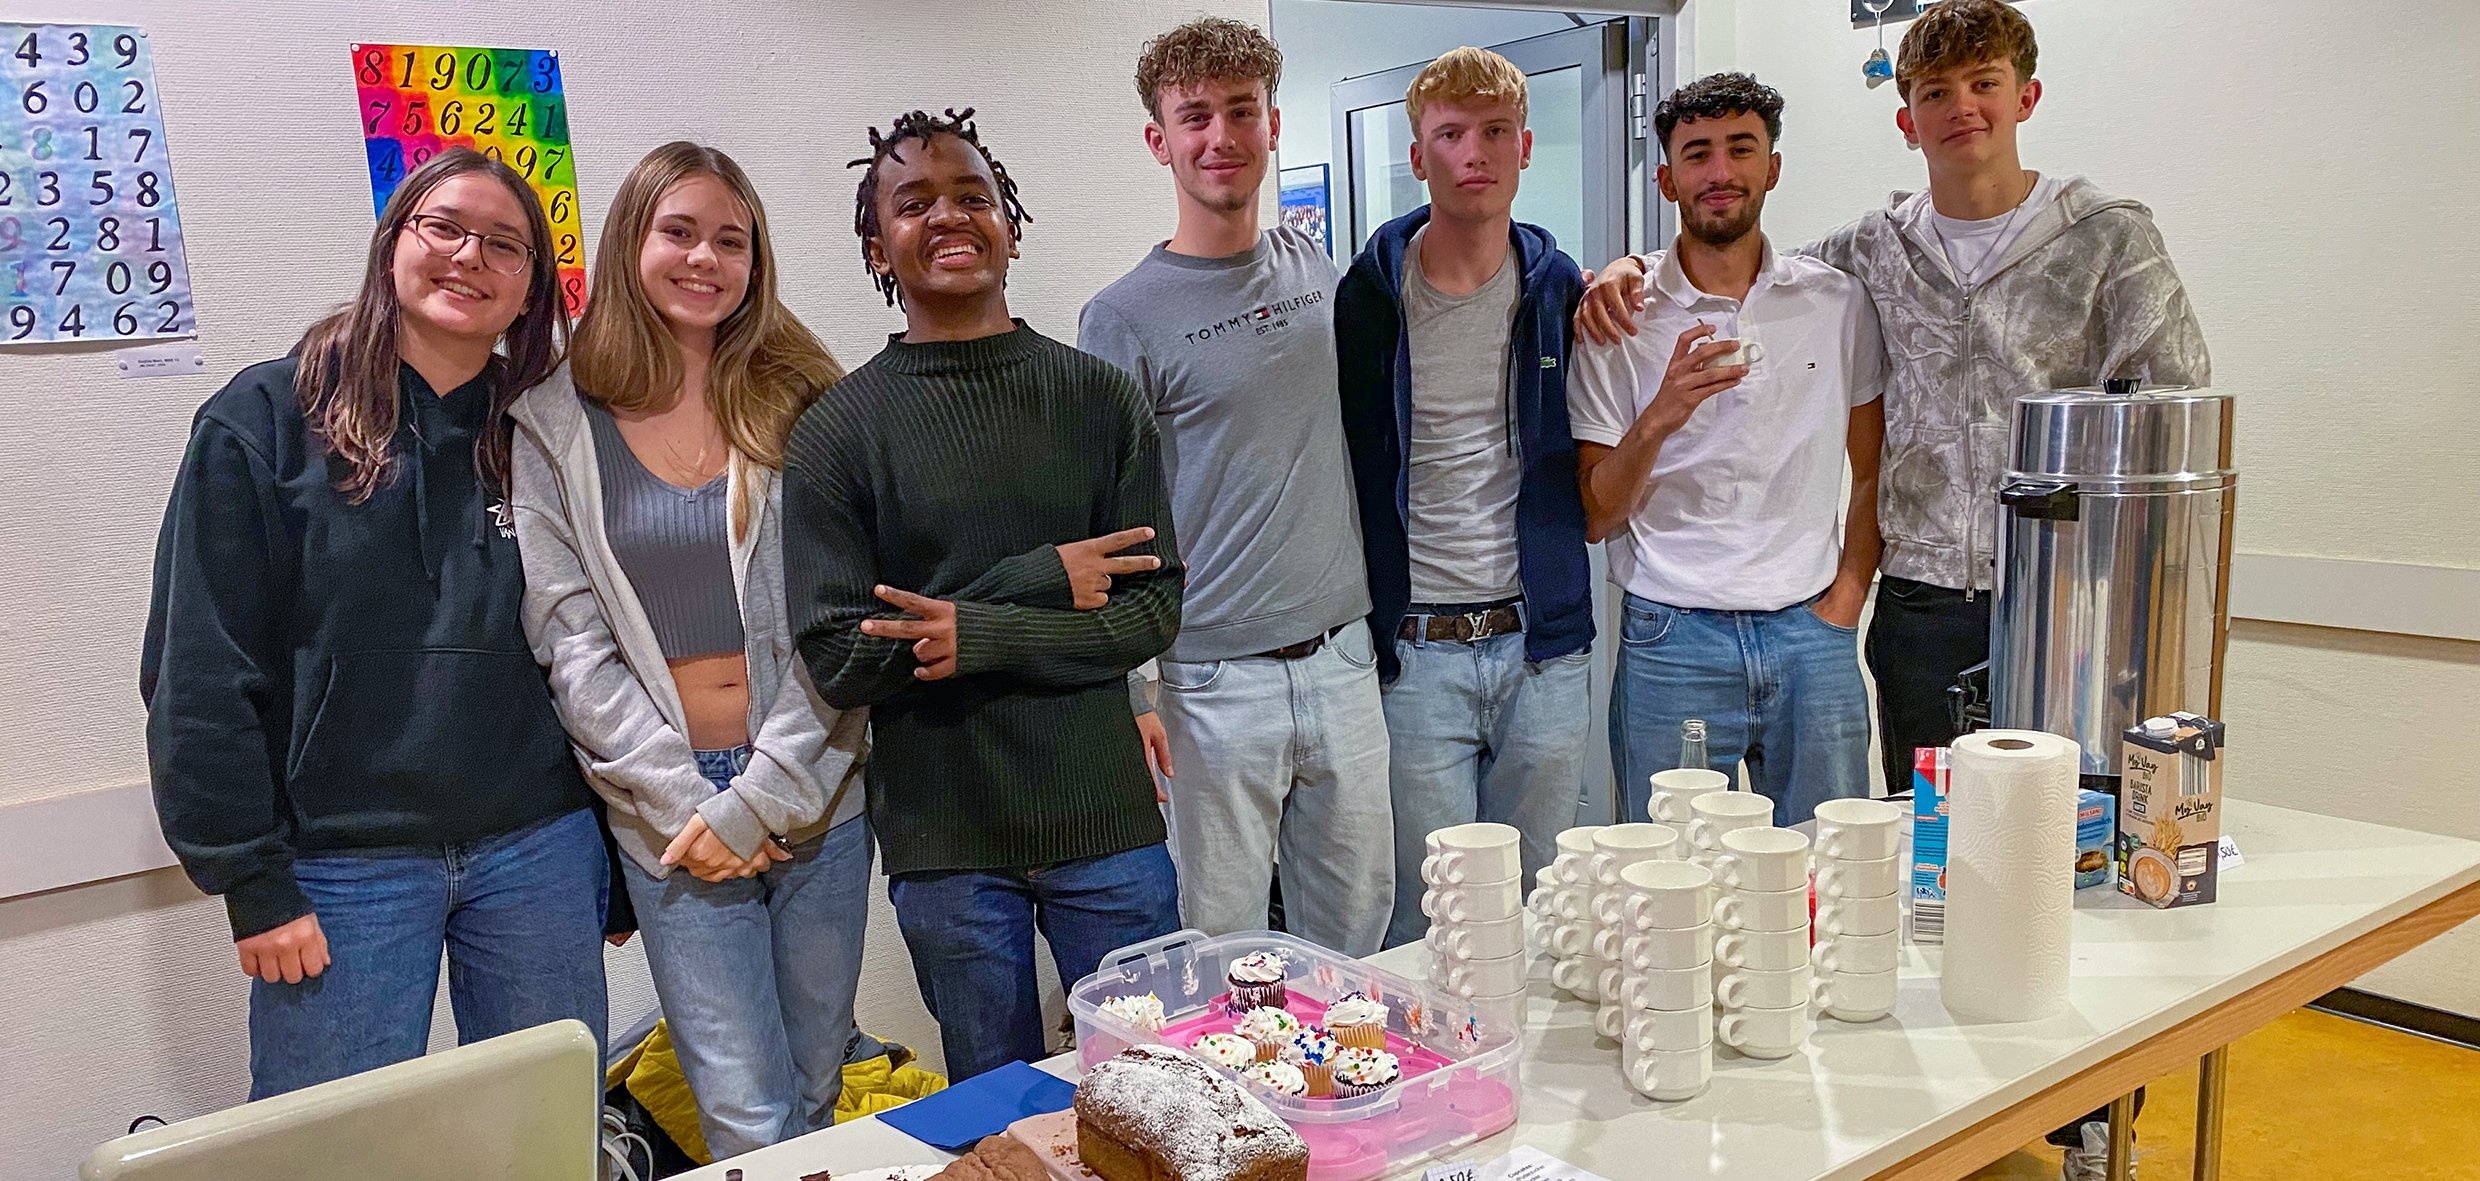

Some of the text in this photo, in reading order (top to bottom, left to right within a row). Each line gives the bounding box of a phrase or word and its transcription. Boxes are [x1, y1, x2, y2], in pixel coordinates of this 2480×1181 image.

[15, 32, 137, 68] 4 3 9
[360, 50, 556, 93] 8 1 9 0 7 3
[23, 80, 146, 114] 6 0 2
[368, 100, 557, 138] 7 5 6 2 4 1
[32, 126, 151, 163] 8 1 7
[516, 146, 538, 180] 9
[545, 148, 565, 180] 7
[37, 171, 60, 206] 3
[89, 170, 113, 205] 5
[137, 171, 160, 207] 8
[551, 191, 571, 223] 6
[47, 217, 70, 250] 2
[97, 217, 120, 251] 8
[145, 218, 165, 252] 1
[557, 234, 577, 265] 2
[9, 260, 172, 296] 1 7 0 9
[563, 278, 582, 311] 8
[10, 301, 181, 340] 9 4 6 2
[1185, 290, 1324, 345] TOMMY HILFIGER
[1256, 324, 1271, 336] EST.
[2175, 803, 2192, 816] My
